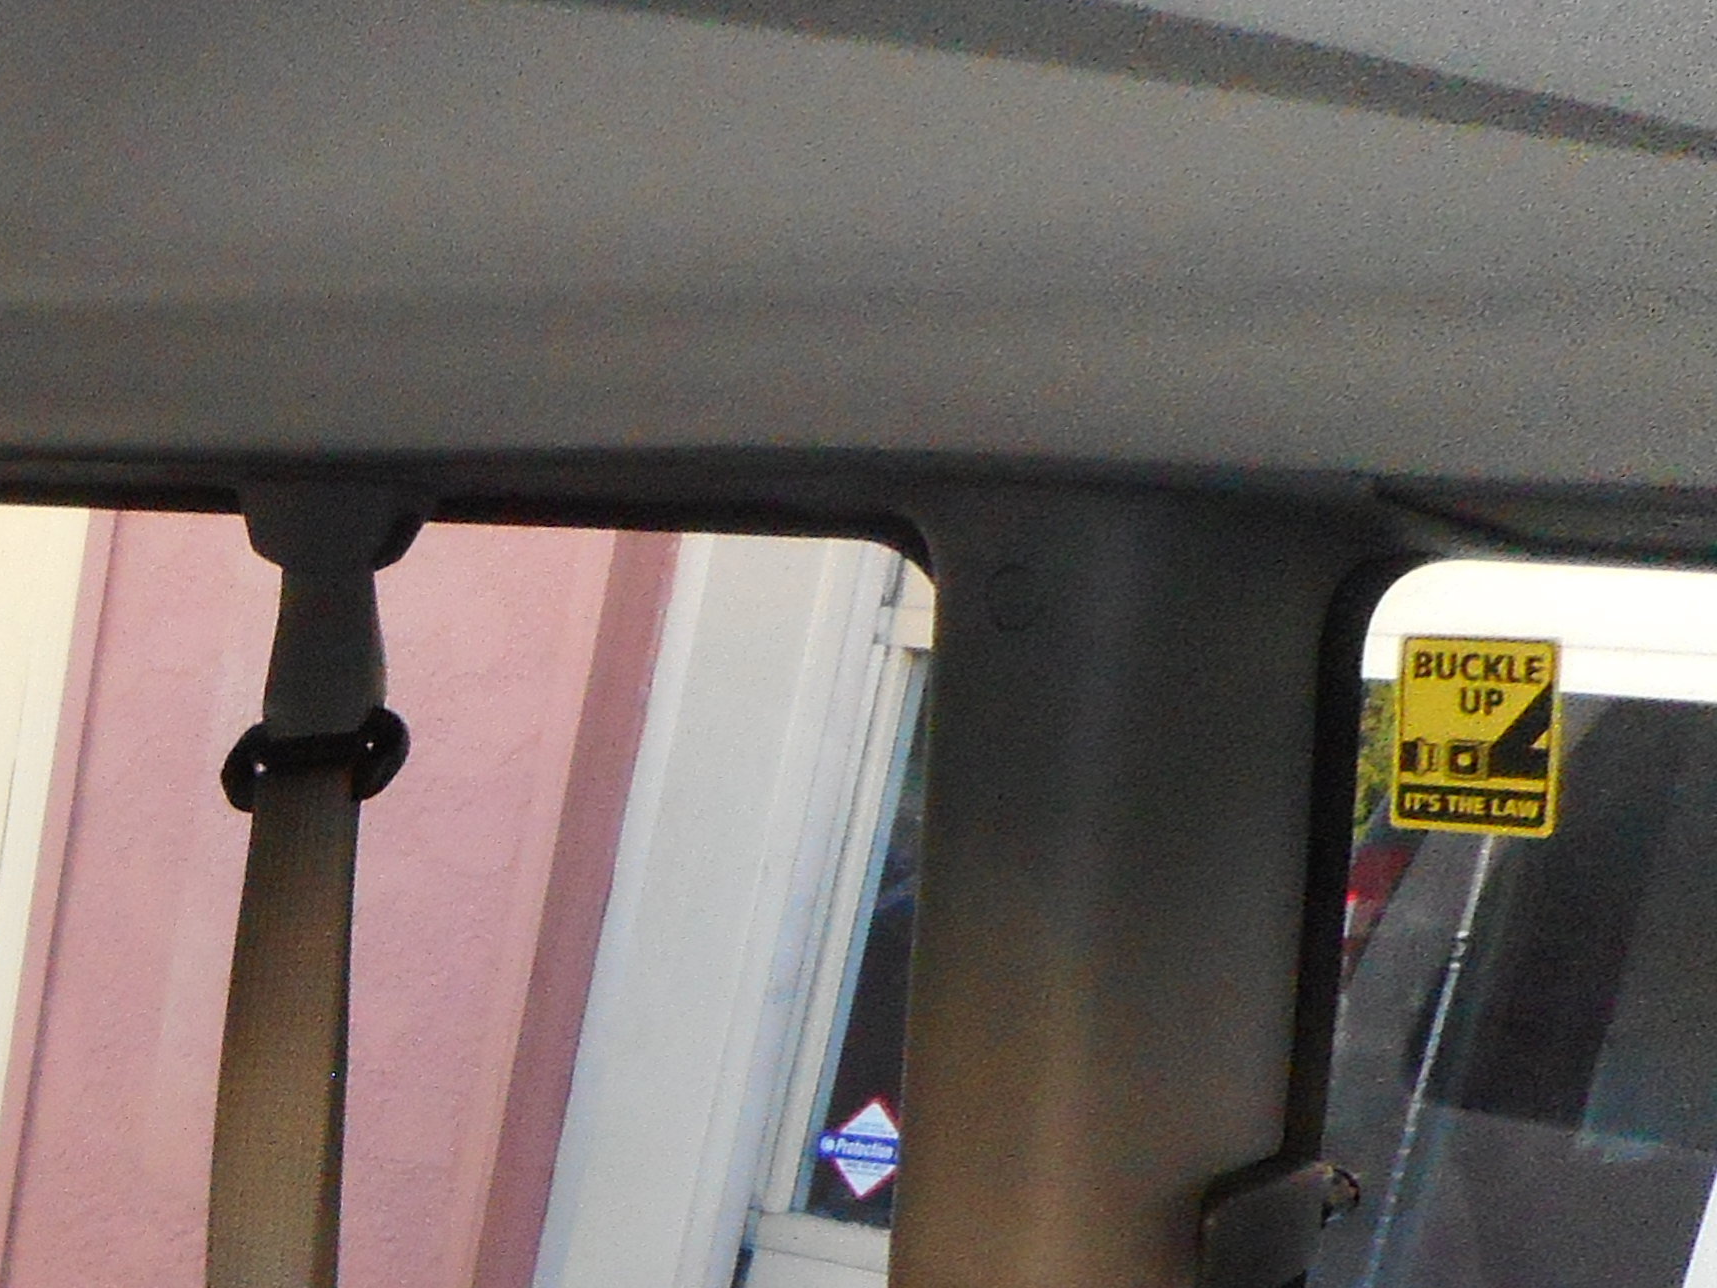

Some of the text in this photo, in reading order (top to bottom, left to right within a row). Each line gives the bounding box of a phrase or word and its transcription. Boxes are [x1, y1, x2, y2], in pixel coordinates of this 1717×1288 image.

[1413, 651, 1545, 684] BUCKLE
[1458, 686, 1504, 716] UP
[1404, 792, 1540, 819] IT'S THE LAW
